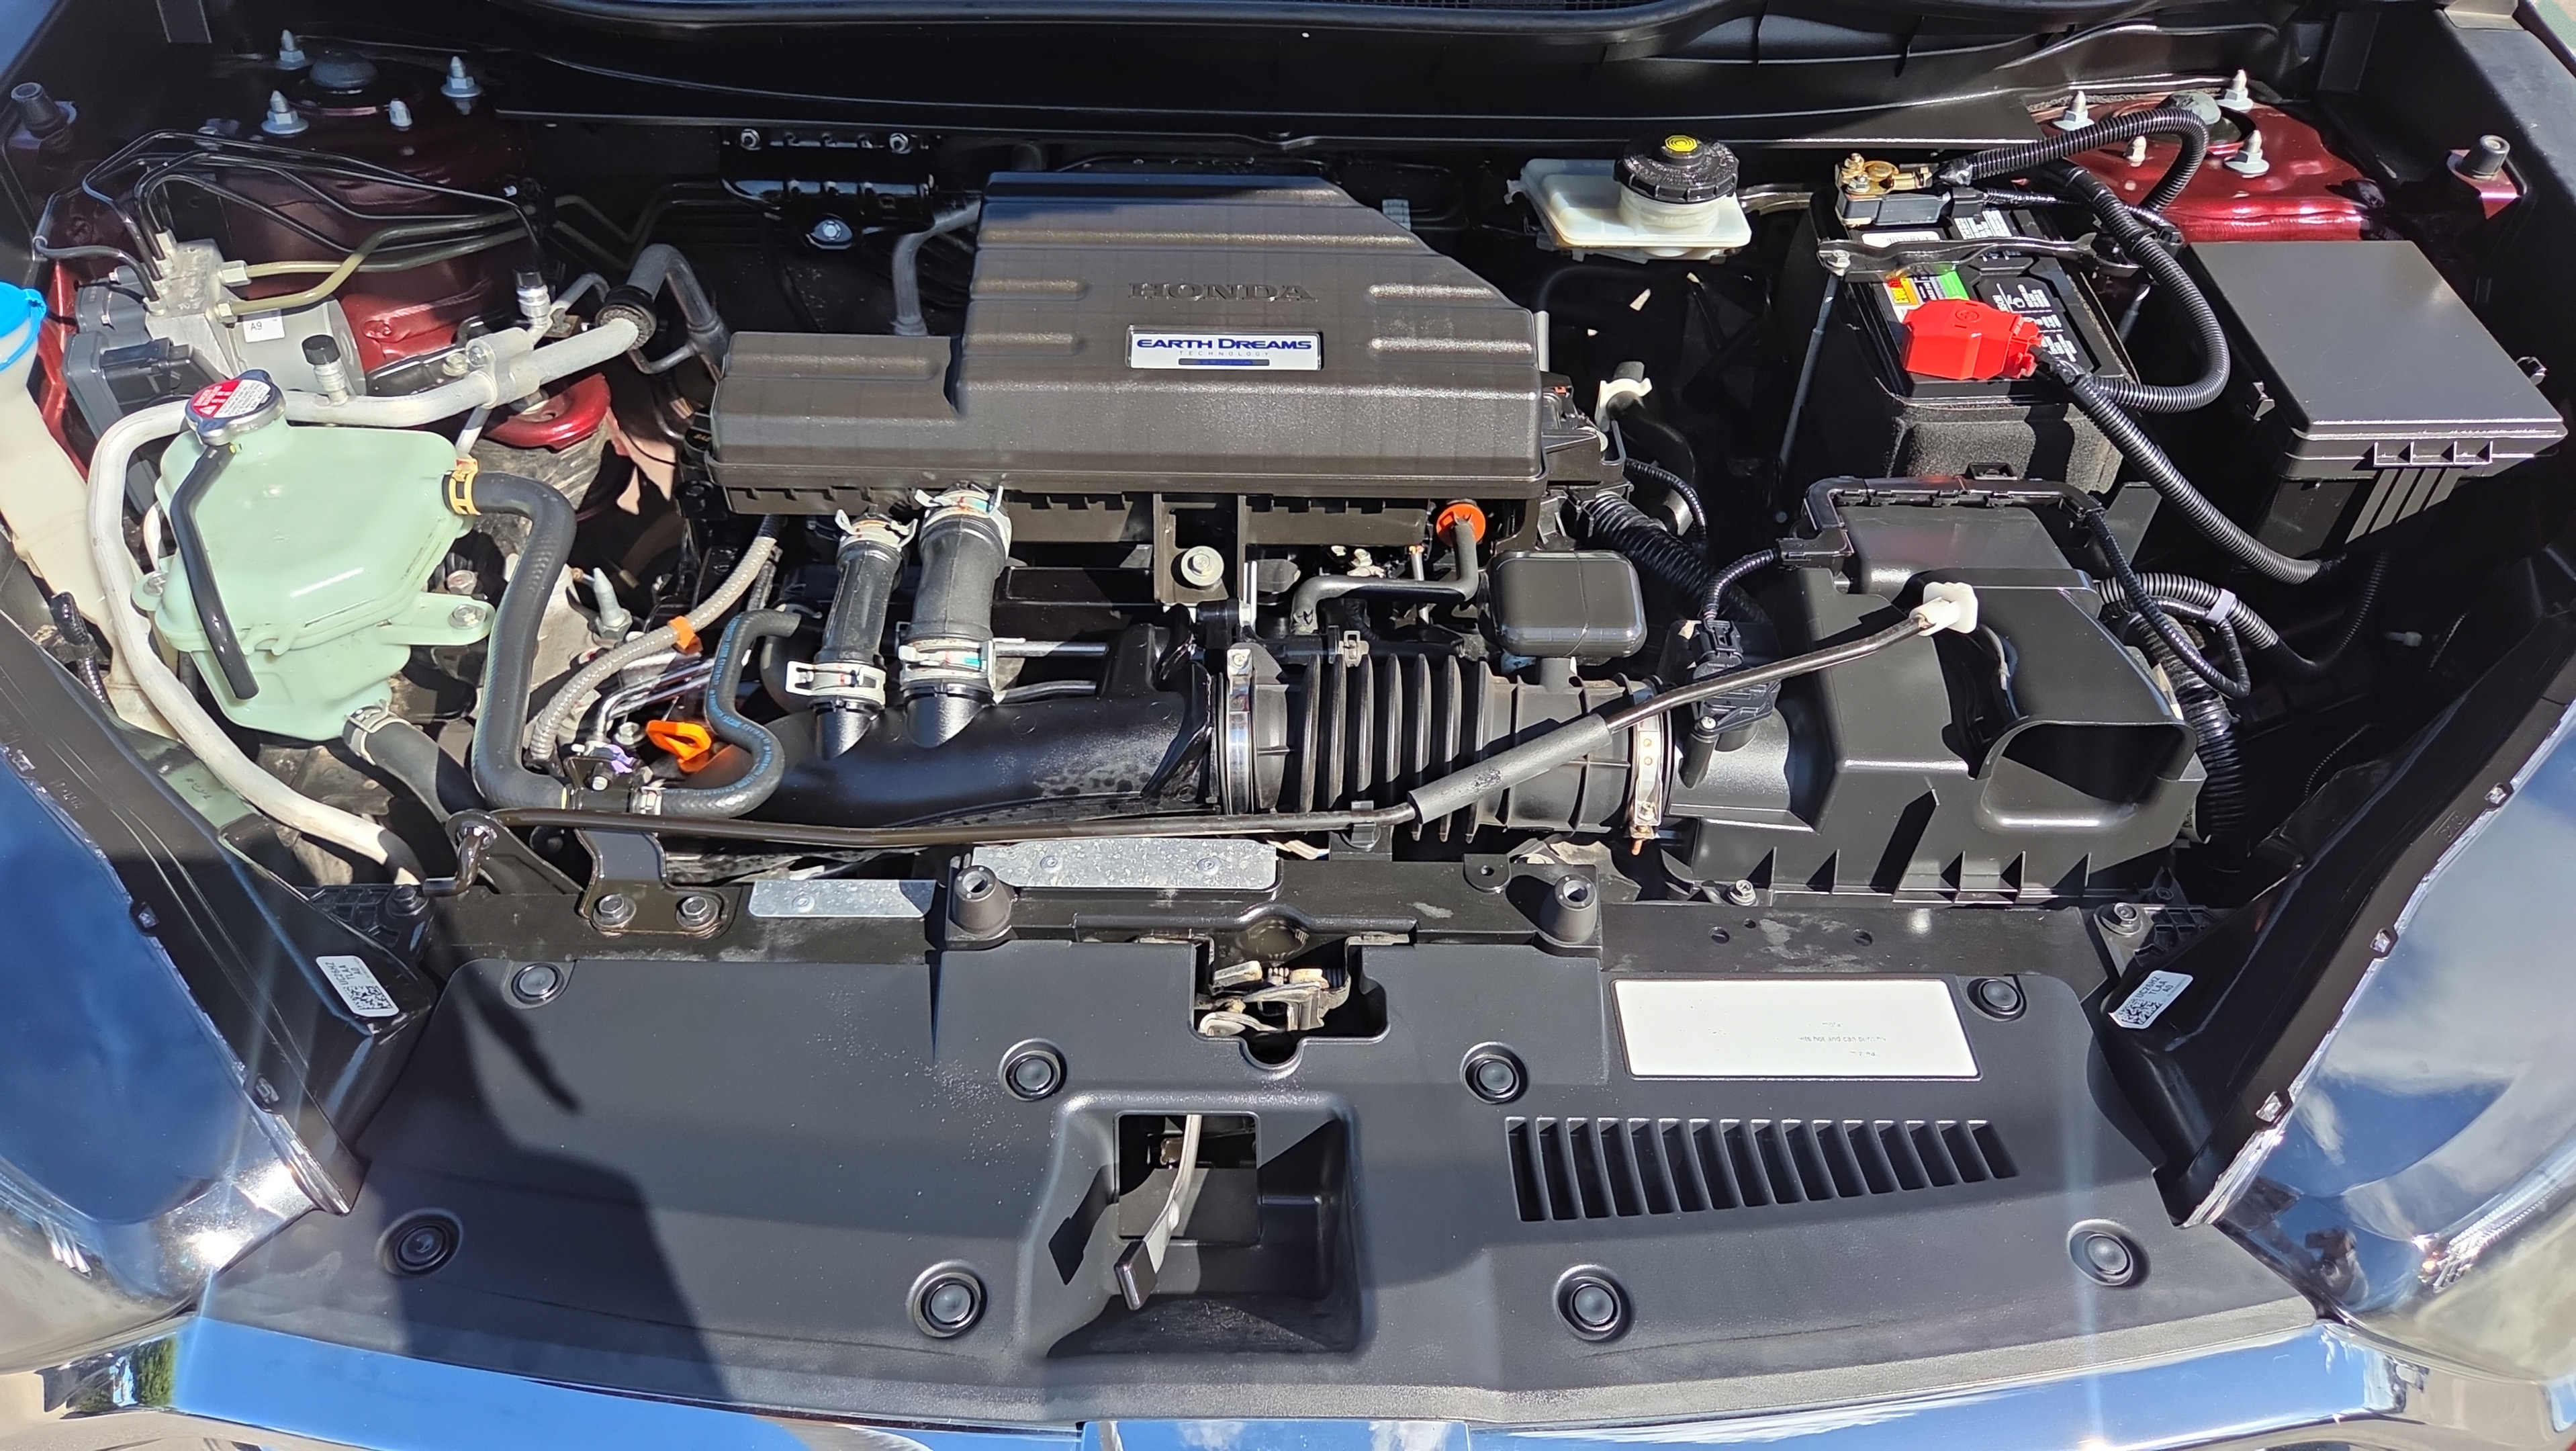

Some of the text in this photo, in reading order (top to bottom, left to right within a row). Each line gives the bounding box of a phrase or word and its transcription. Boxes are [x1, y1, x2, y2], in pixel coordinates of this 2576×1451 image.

[1128, 283, 1318, 302] HONDA
[250, 321, 263, 331] A9
[1136, 338, 1312, 349] EARTH DREAMS
